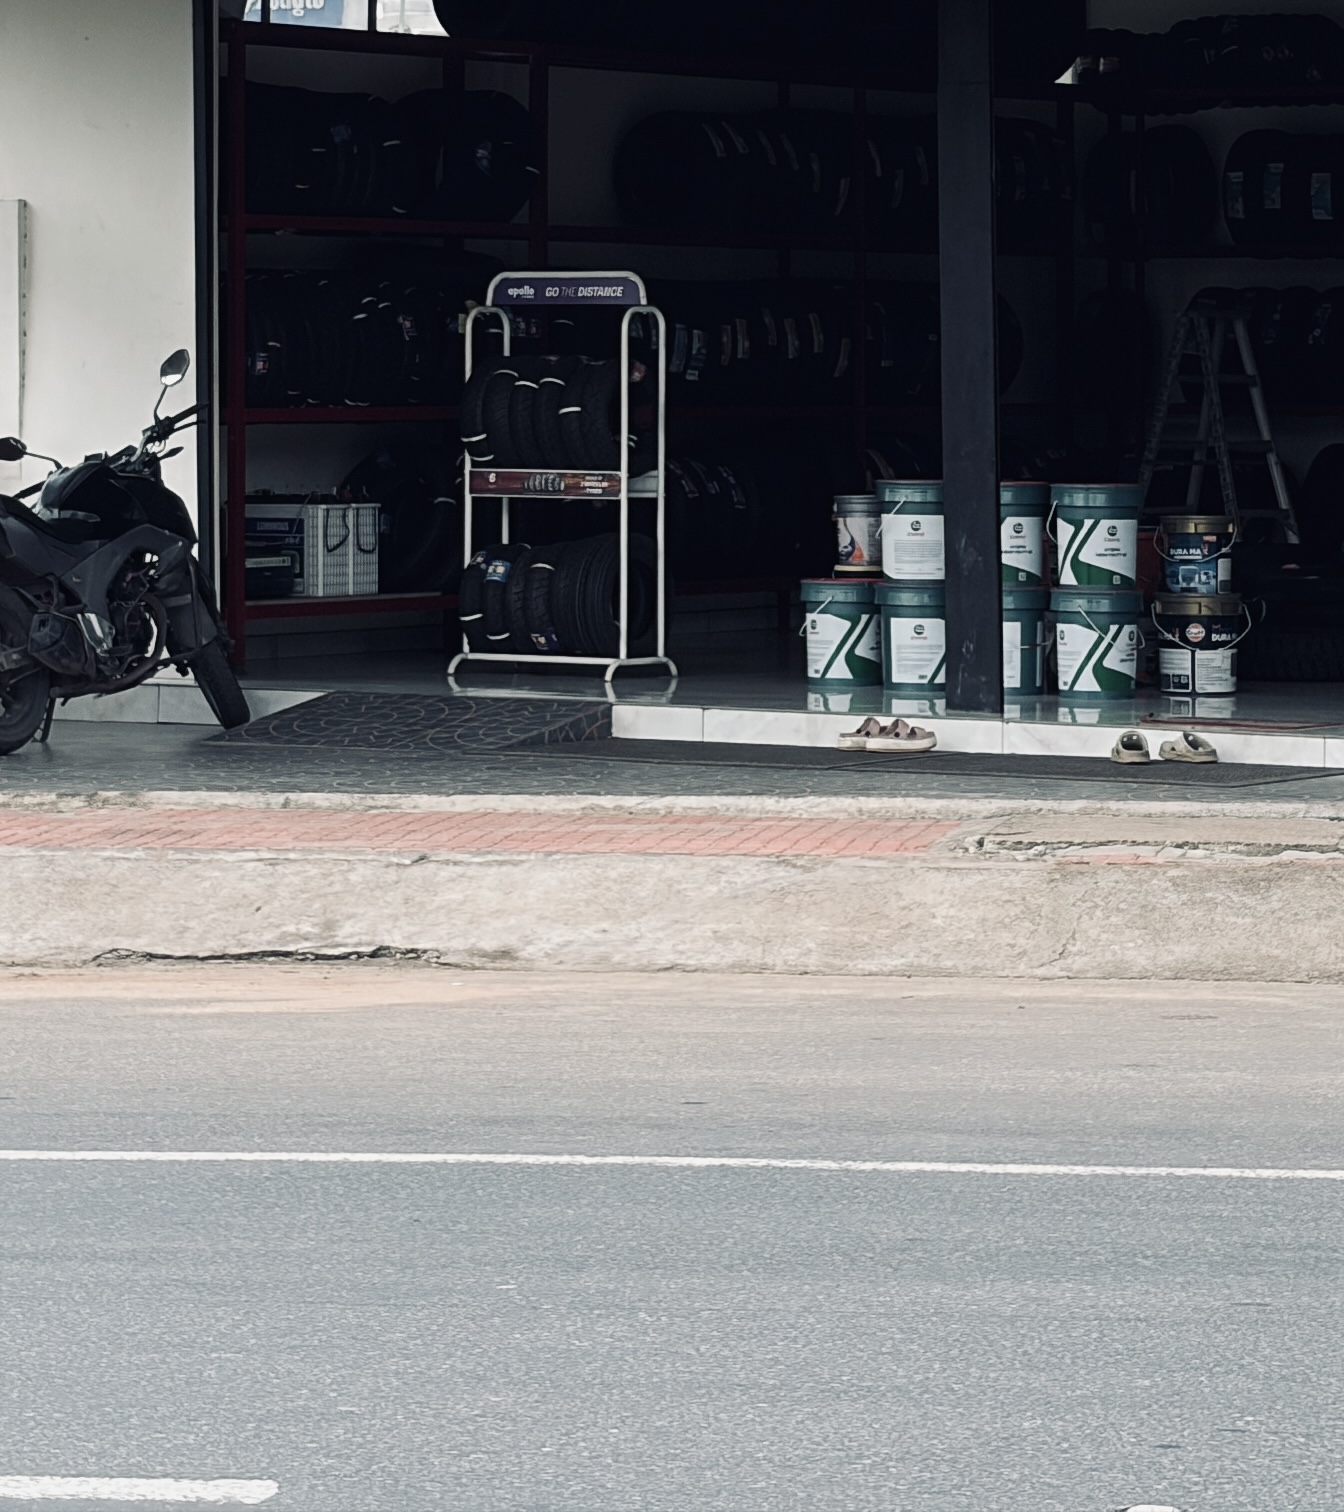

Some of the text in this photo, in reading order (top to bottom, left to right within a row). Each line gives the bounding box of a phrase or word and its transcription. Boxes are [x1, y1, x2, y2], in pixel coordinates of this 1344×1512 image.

[545, 287, 559, 297] GO
[561, 287, 577, 297] THE
[578, 286, 623, 297] DISTANCE
